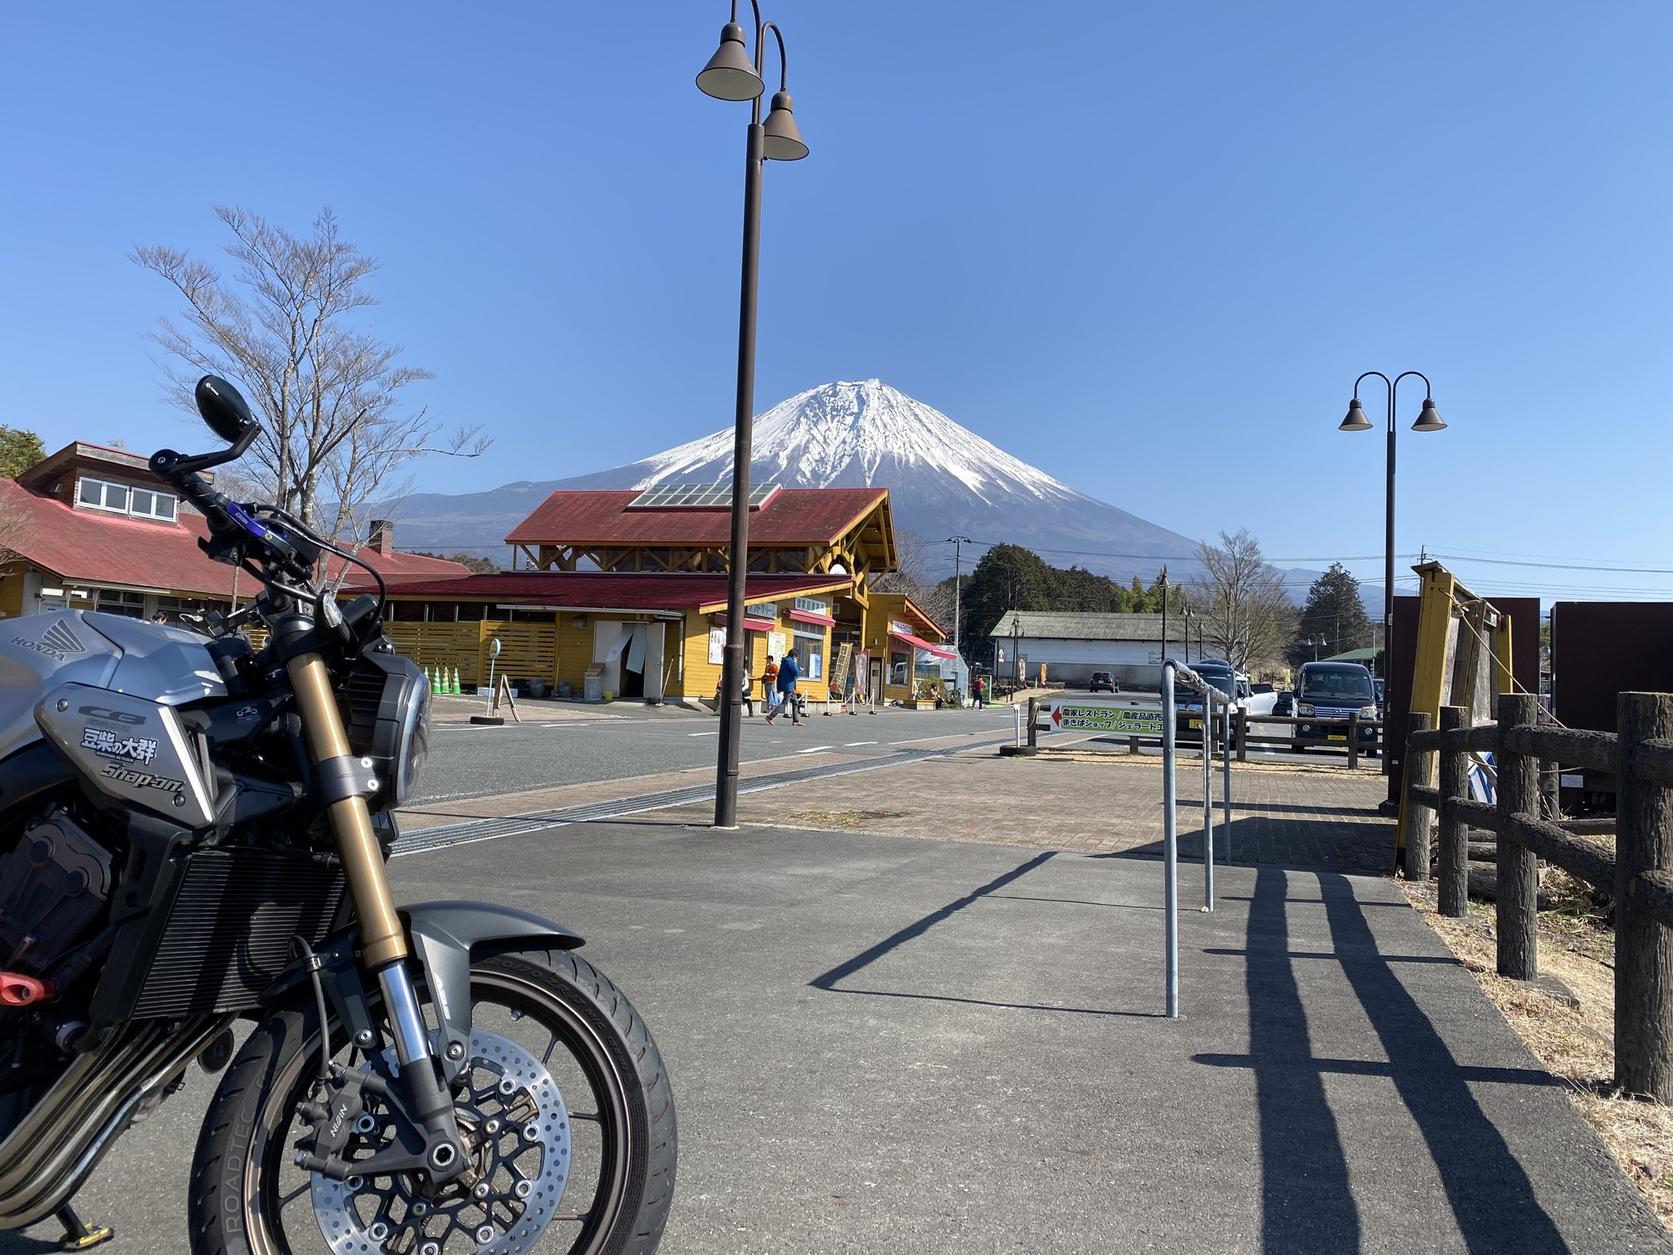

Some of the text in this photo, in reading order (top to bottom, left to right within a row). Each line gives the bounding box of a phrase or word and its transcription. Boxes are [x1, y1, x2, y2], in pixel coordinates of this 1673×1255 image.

[9, 636, 65, 663] HONDA
[81, 727, 158, 766] 豆柴の大群
[225, 1108, 255, 1234] ROADTEC
